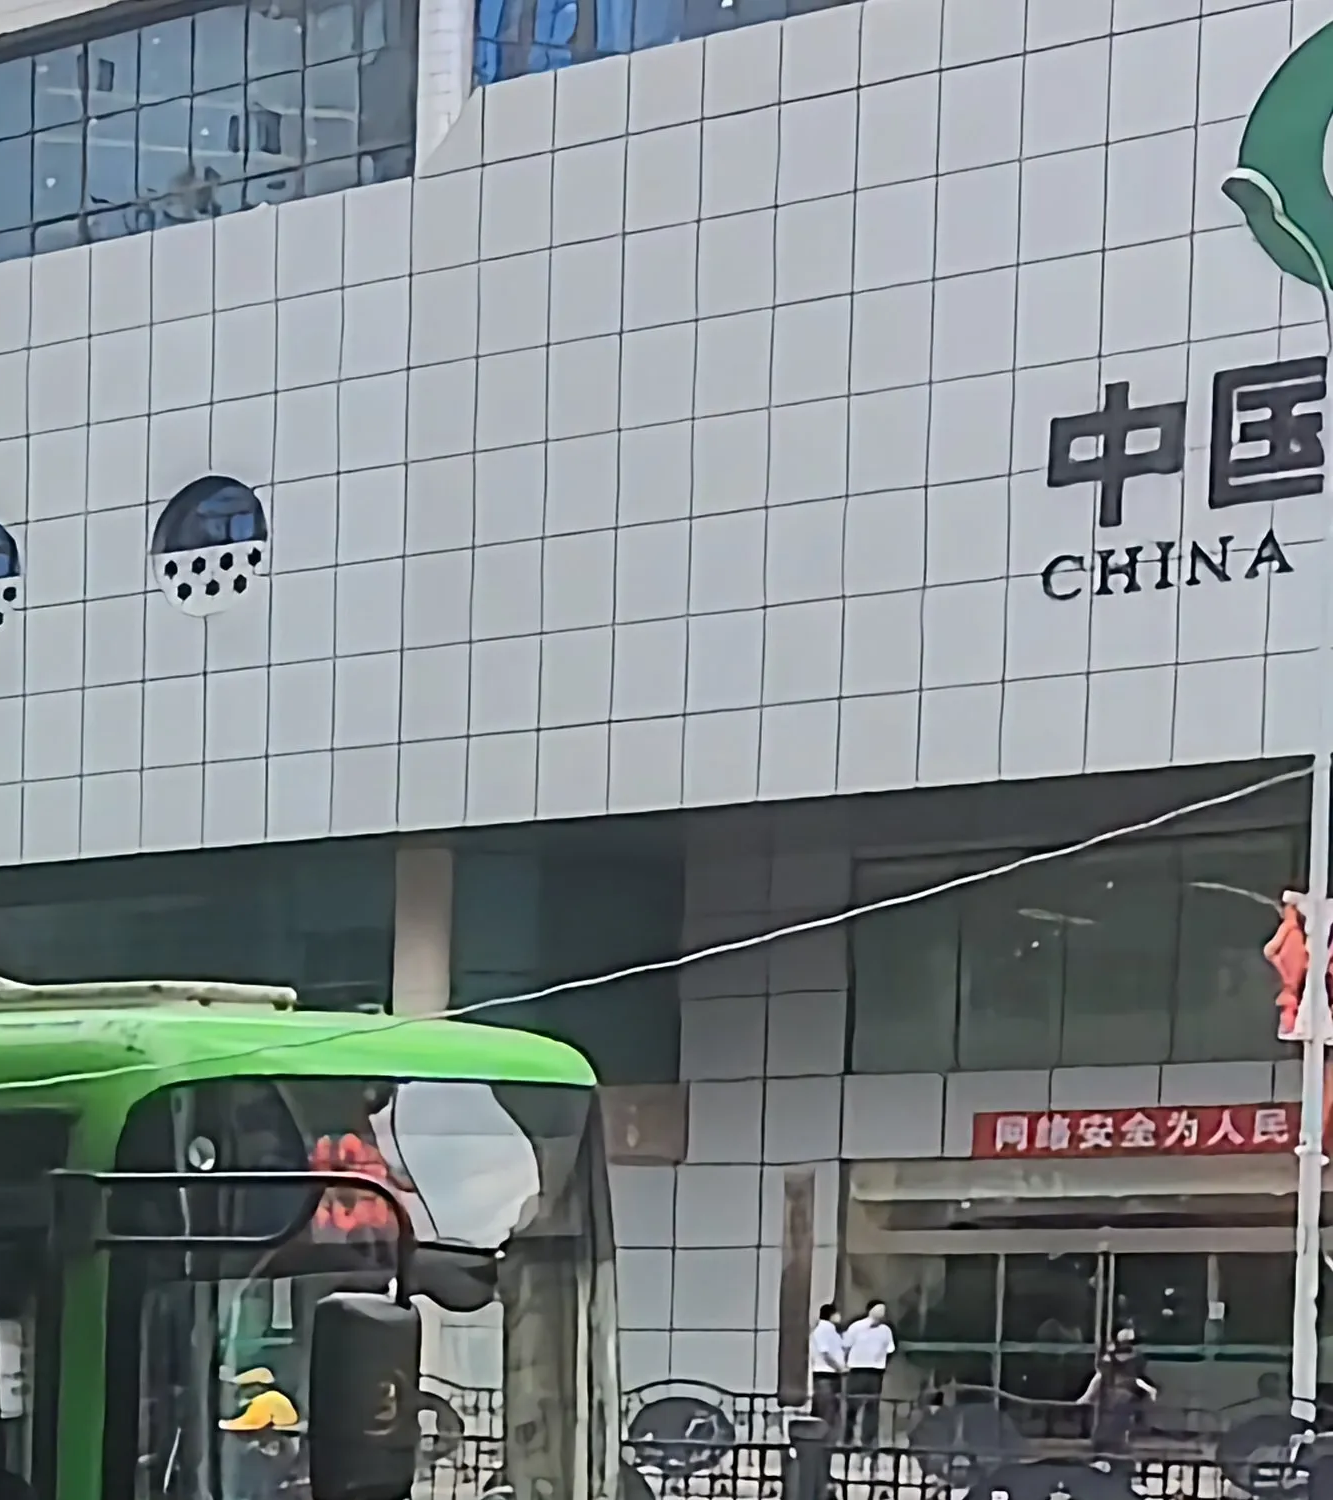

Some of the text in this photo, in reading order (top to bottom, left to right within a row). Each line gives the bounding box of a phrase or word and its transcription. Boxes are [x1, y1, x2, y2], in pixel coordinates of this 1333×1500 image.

[1047, 355, 1328, 527] 中国
[1042, 529, 1294, 600] CHINA
[994, 1108, 1289, 1151] 网络安全为人民
